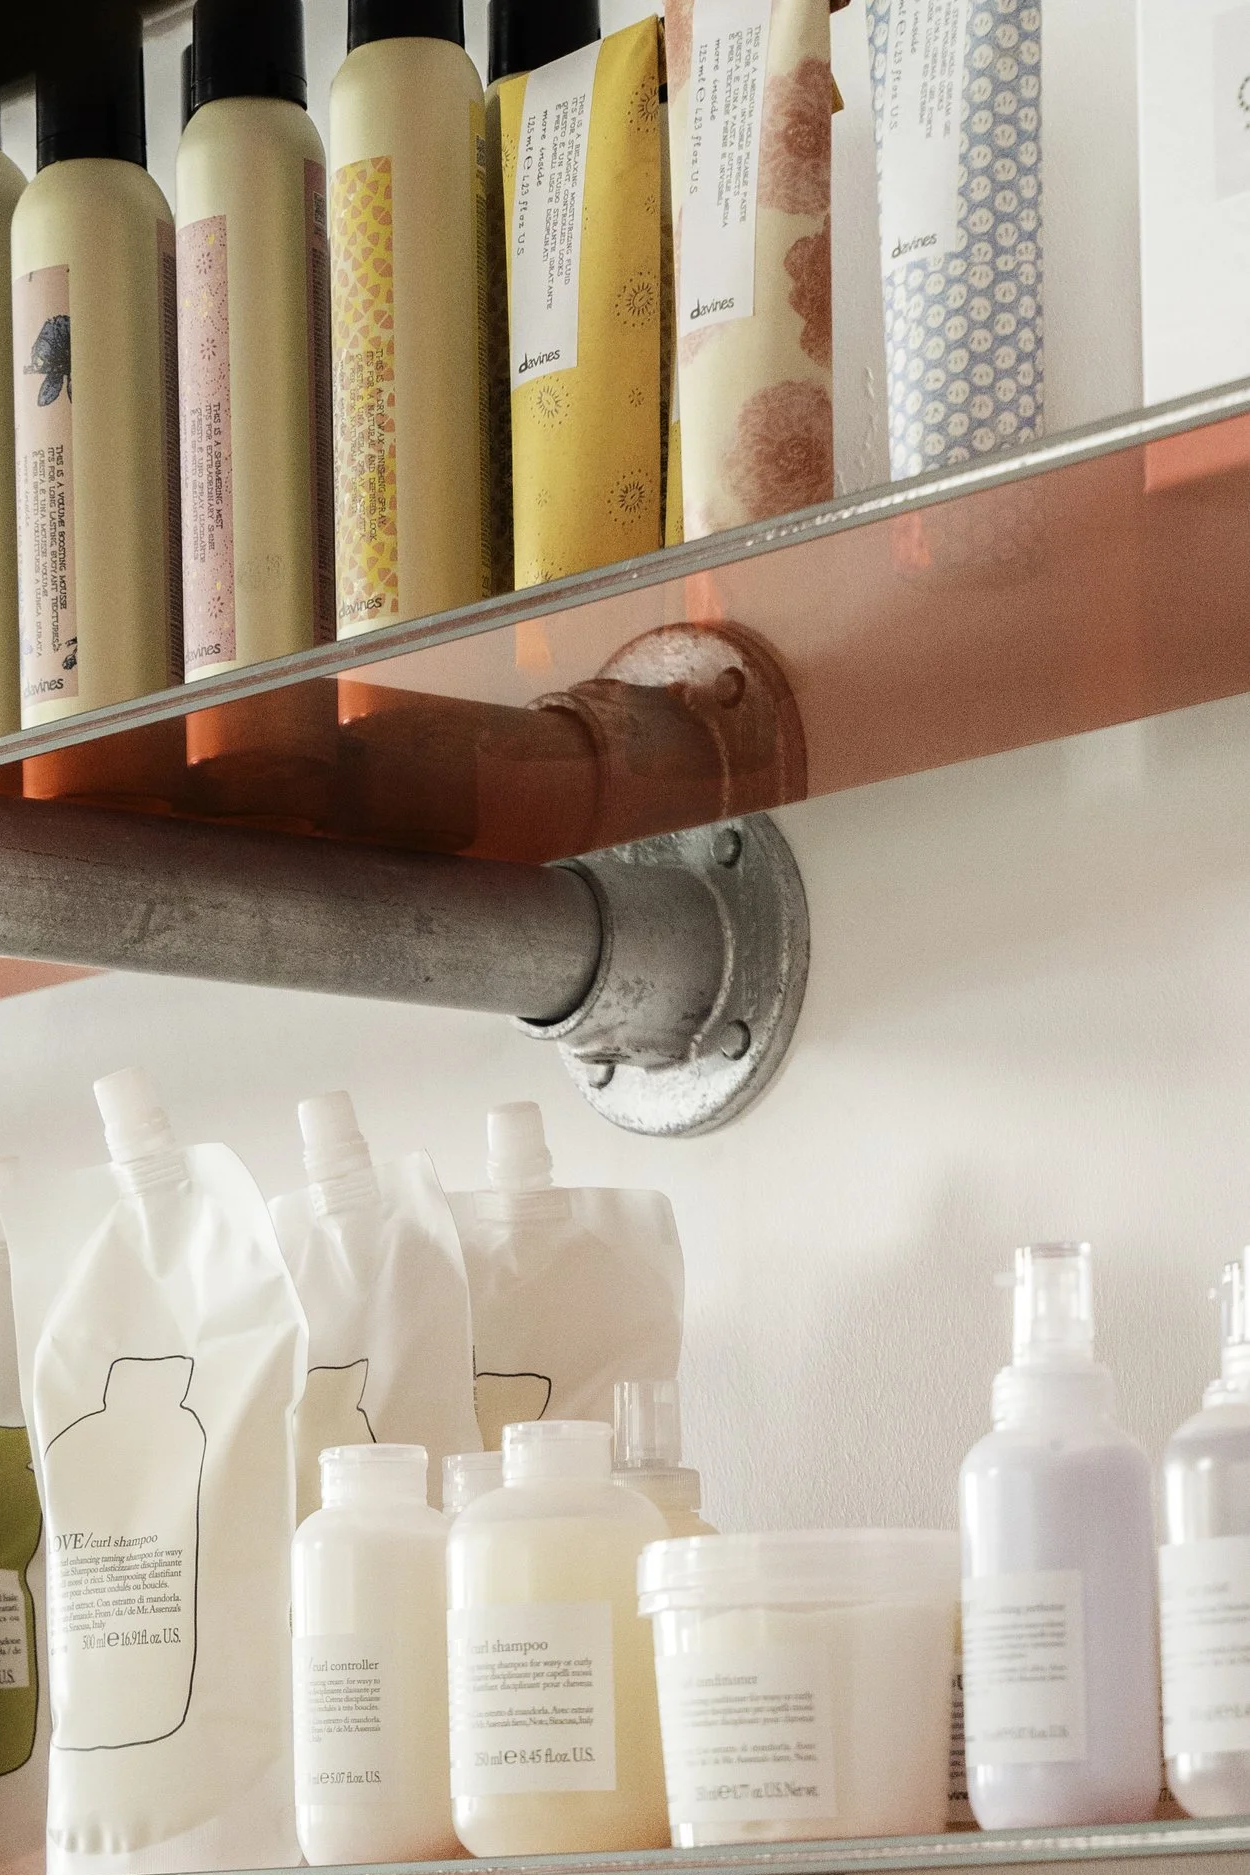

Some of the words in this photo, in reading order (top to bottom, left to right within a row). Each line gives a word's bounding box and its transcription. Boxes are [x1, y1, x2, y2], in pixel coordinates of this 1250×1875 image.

[710, 78, 719, 120] inside
[576, 119, 582, 127] IS
[537, 146, 545, 186] inside
[557, 153, 564, 167] UN
[571, 143, 579, 187] RELAXING
[554, 172, 562, 203] FLUIDO
[559, 189, 569, 244] CONTROLLED
[566, 192, 575, 254] MOISTURIZING
[891, 233, 938, 259] davines
[546, 257, 555, 309] IDRATANTE
[690, 297, 735, 319] davines
[519, 349, 561, 373] davines
[212, 402, 220, 423] THIS
[214, 427, 220, 435] IS
[55, 444, 63, 465] THIS
[56, 469, 63, 477] IS
[204, 445, 215, 519] EXTRAORDINARY
[213, 450, 223, 504] SHIMMERING
[57, 491, 65, 527] VOLUME
[215, 508, 223, 529] MIST
[57, 530, 65, 571] BOOSTING
[339, 596, 383, 618] davines
[114, 1534, 158, 1549] shampoo
[126, 1551, 153, 1561] shampoo
[154, 1548, 164, 1557] for
[165, 1549, 183, 1559] wavy
[141, 1559, 182, 1569] disciplinante
[106, 1573, 147, 1584] Shampooing
[97, 1599, 110, 1607] Con
[146, 1593, 182, 1603] mandorla.
[163, 1628, 181, 1643] U.S.
[492, 1639, 548, 1655] shampoo
[330, 1659, 380, 1671] controller
[519, 1749, 541, 1764] 8.45
[572, 1746, 595, 1762] U.S.
[365, 1770, 382, 1784] U.S.
